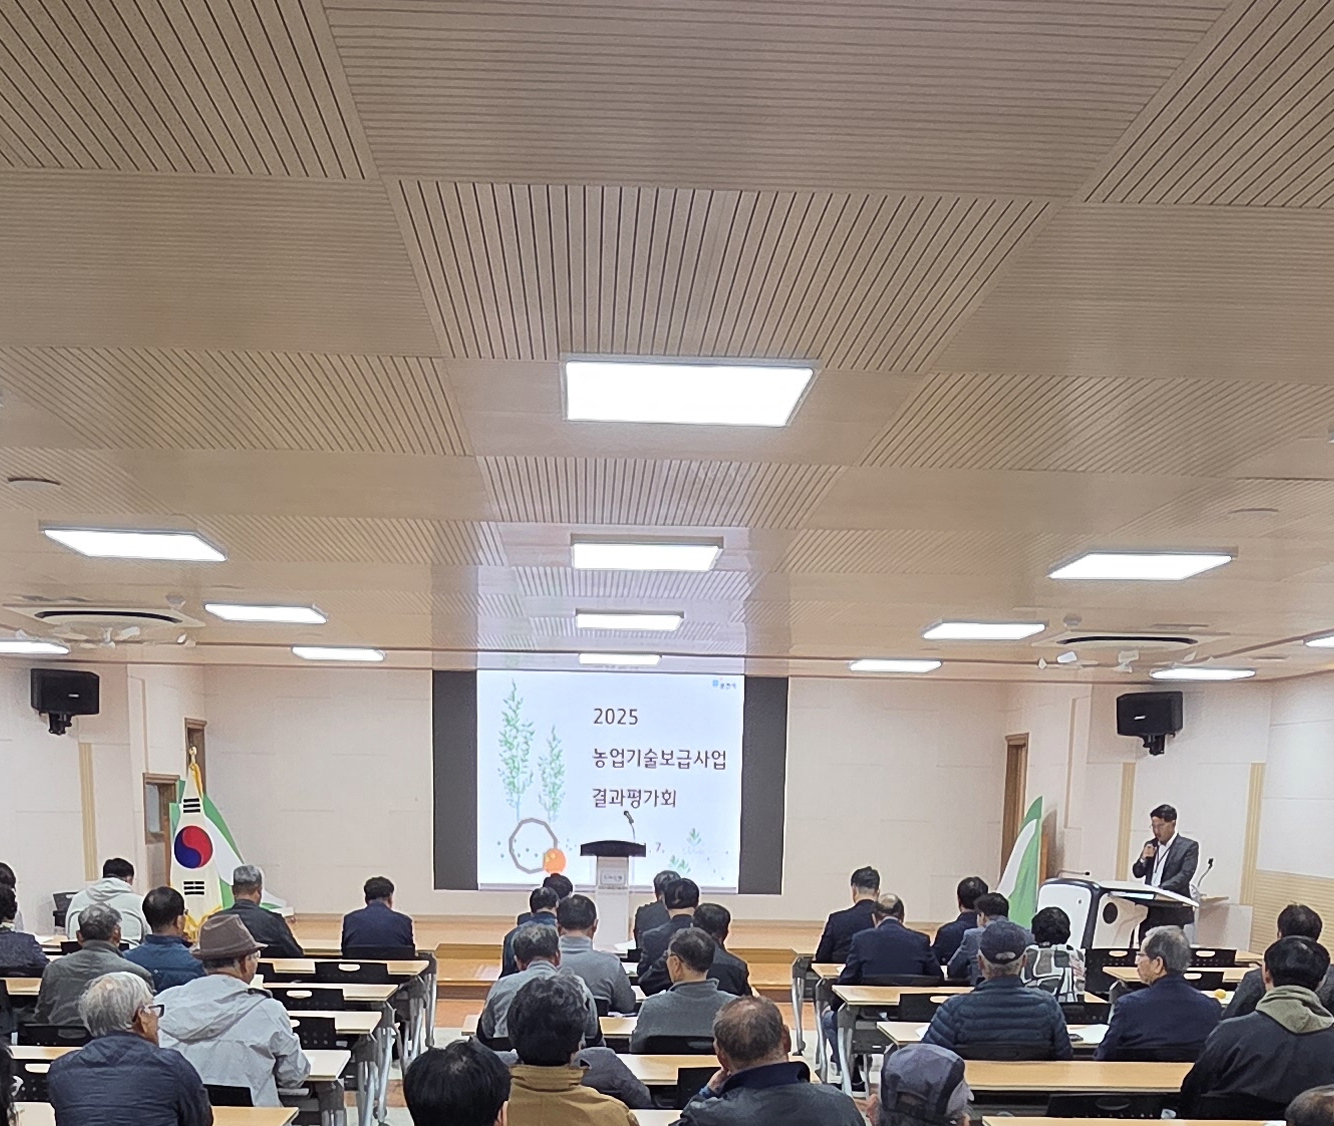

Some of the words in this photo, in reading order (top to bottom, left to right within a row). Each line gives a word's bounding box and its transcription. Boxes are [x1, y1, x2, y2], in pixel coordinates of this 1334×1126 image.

[593, 707, 639, 725] 2025
[592, 748, 727, 770] 농업기술보급사업
[592, 788, 677, 808] 결과평가회
